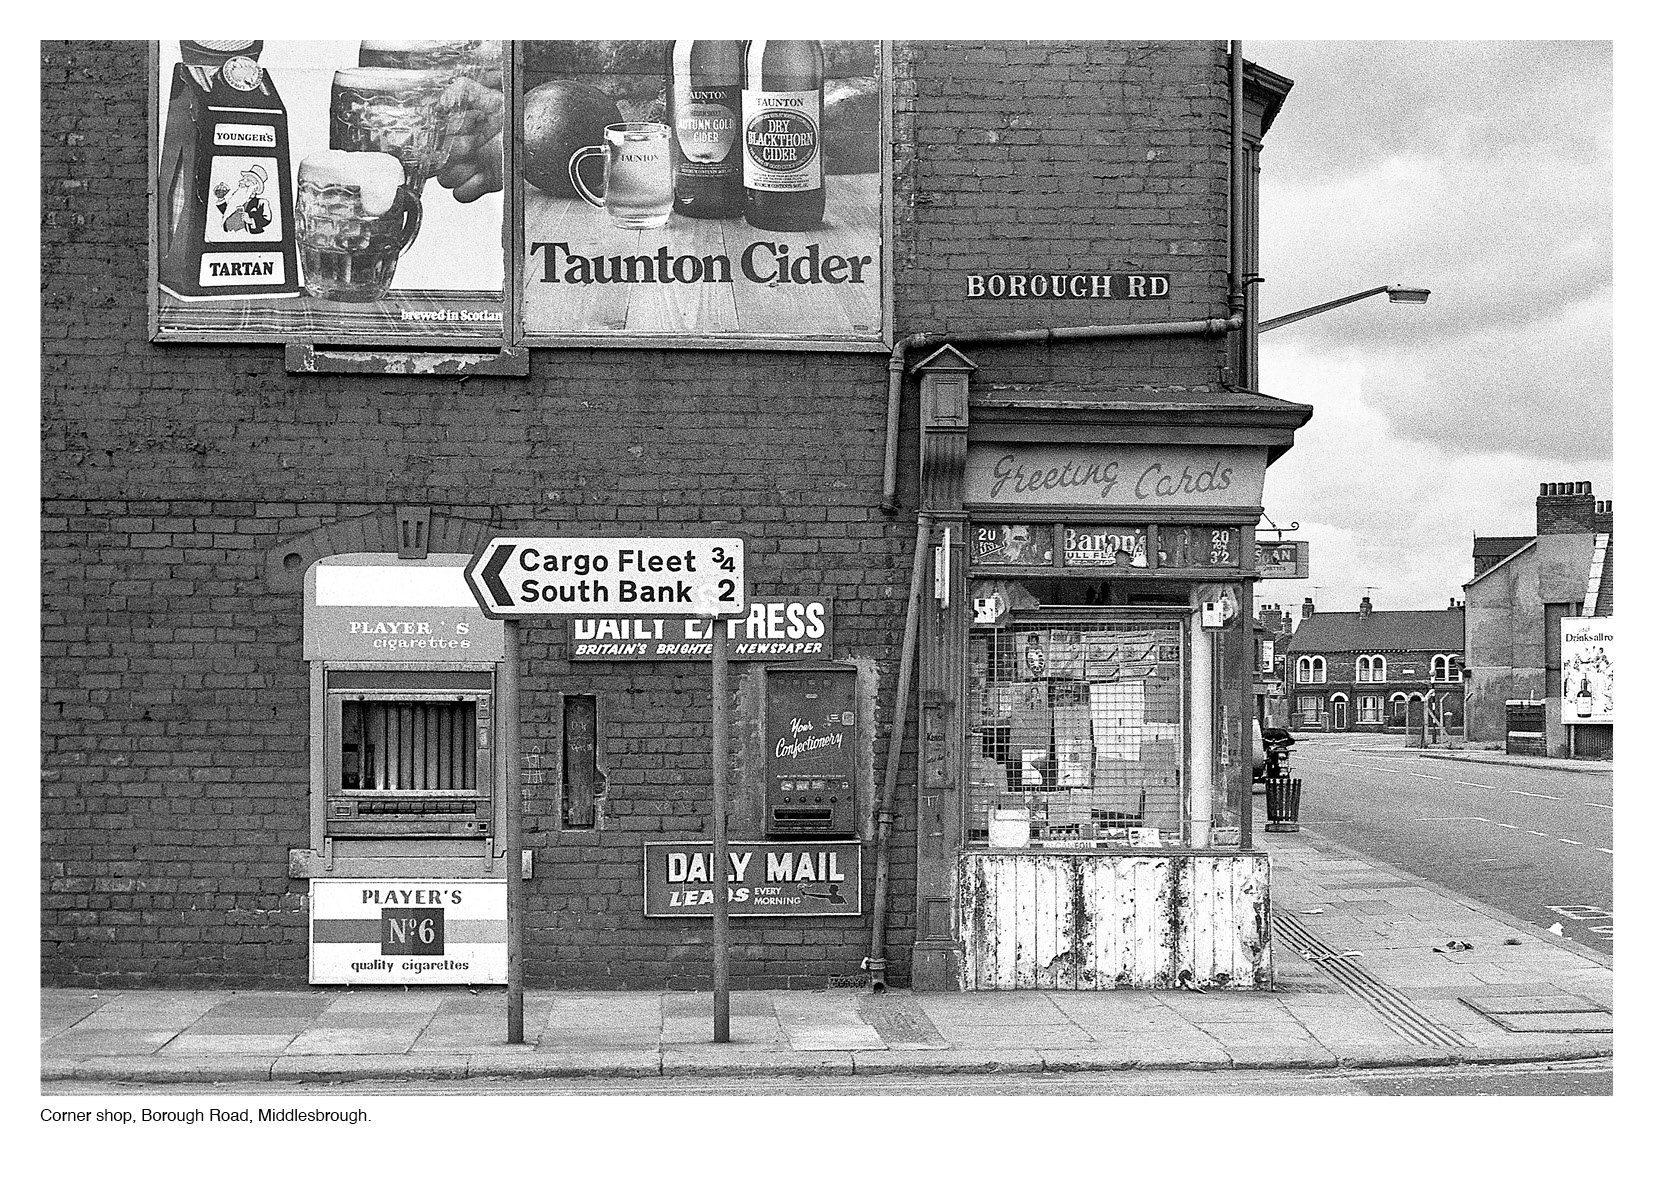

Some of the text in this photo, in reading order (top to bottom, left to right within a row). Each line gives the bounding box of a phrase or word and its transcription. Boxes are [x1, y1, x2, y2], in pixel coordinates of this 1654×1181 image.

[768, 119, 790, 133] DRY
[216, 132, 274, 142] YOUNGER'S
[693, 131, 719, 143] CIDER
[748, 131, 813, 147] BLACKTHORN
[762, 147, 797, 161] CIDER
[209, 261, 275, 277] TARTAN
[530, 241, 872, 284] Taunton Cider
[967, 274, 1169, 298] BOROUGH RD
[400, 308, 445, 321] brewed
[446, 309, 459, 321] in
[990, 454, 1233, 500] Greeting Cards
[1211, 530, 1229, 543] 20
[519, 548, 609, 576] Cargo
[618, 549, 697, 572] Fleet
[520, 579, 735, 603] South Bank 2
[373, 636, 471, 651] cigarettes
[1565, 633, 1593, 642] Drinks
[1594, 633, 1604, 642] all
[575, 643, 647, 656] BRITAIN'S
[735, 642, 822, 655] NEWSPAPER
[790, 718, 813, 738] Your
[775, 732, 843, 759] Confectionery
[766, 852, 845, 882] MAIL
[362, 889, 463, 905] PLAYER'S
[754, 887, 782, 896] EVERY
[754, 897, 801, 905] MORNING
[351, 959, 470, 974] quality cigarettes
